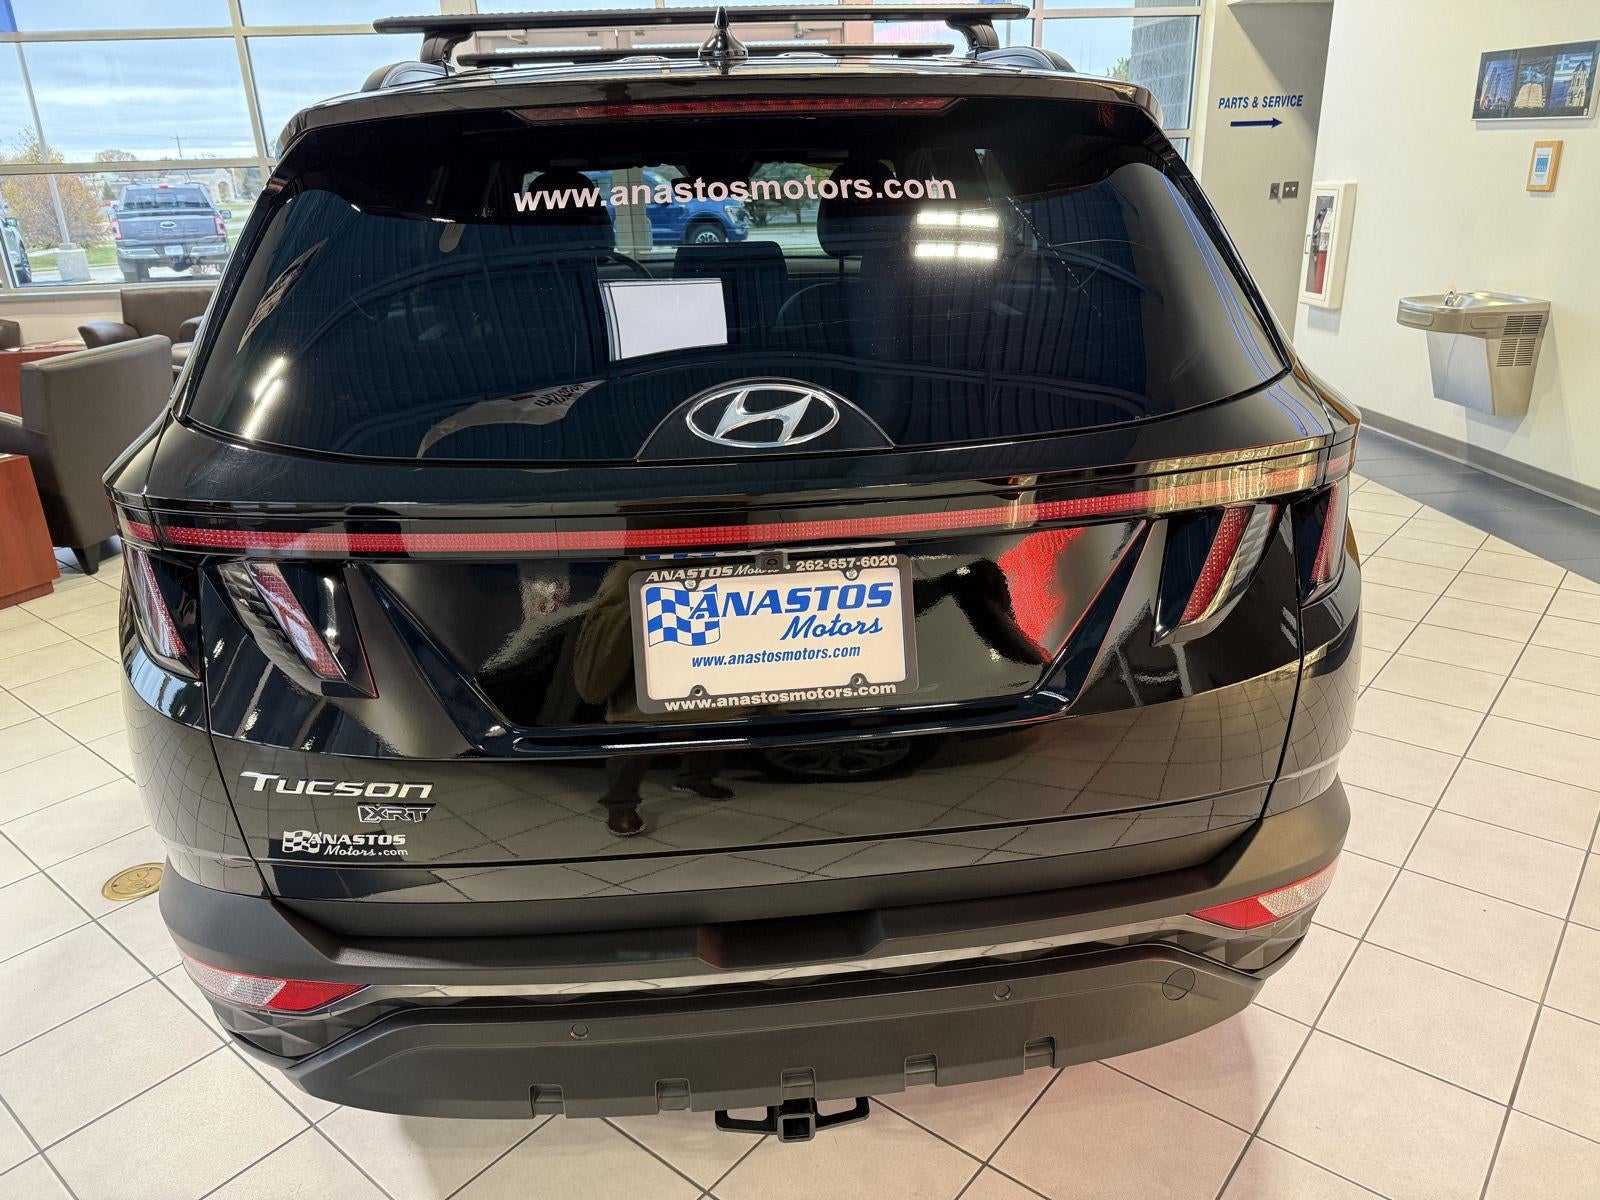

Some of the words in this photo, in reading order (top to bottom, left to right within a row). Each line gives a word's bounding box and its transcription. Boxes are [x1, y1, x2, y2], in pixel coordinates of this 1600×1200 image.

[1218, 96, 1249, 109] PARTS
[1252, 96, 1259, 109] &
[1262, 94, 1304, 108] SERVICE
[513, 175, 957, 212] www.anastosmotors.com
[645, 566, 734, 582] ANASTOS
[796, 555, 898, 572] 262-657-6020
[689, 582, 894, 619] ANASTOS
[780, 613, 883, 640] Motors
[692, 645, 861, 668] www.anastosmotors.com
[665, 683, 897, 711] www.anastosmotors.com
[358, 804, 432, 823] XRT
[308, 832, 406, 846] ANASTOS
